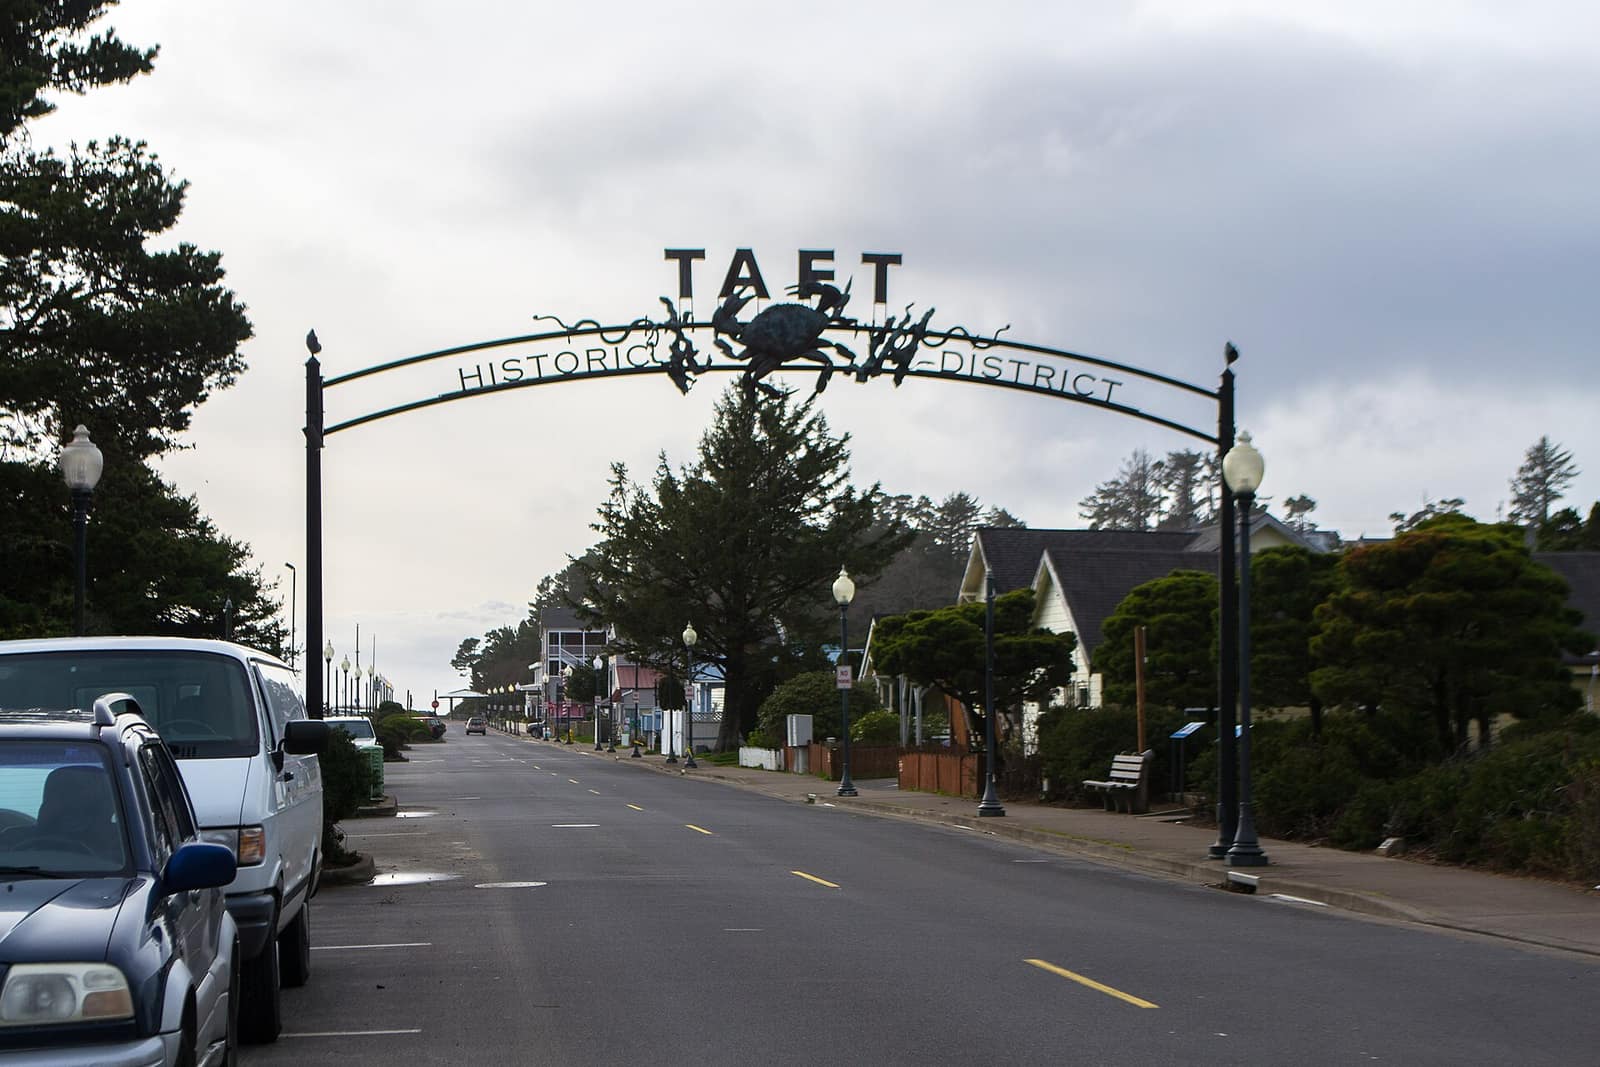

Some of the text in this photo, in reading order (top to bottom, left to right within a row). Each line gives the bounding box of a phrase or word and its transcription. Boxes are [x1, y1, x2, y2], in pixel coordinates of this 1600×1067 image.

[664, 248, 901, 303] TAFT
[458, 345, 1123, 402] HISTORIC DISTRICT
